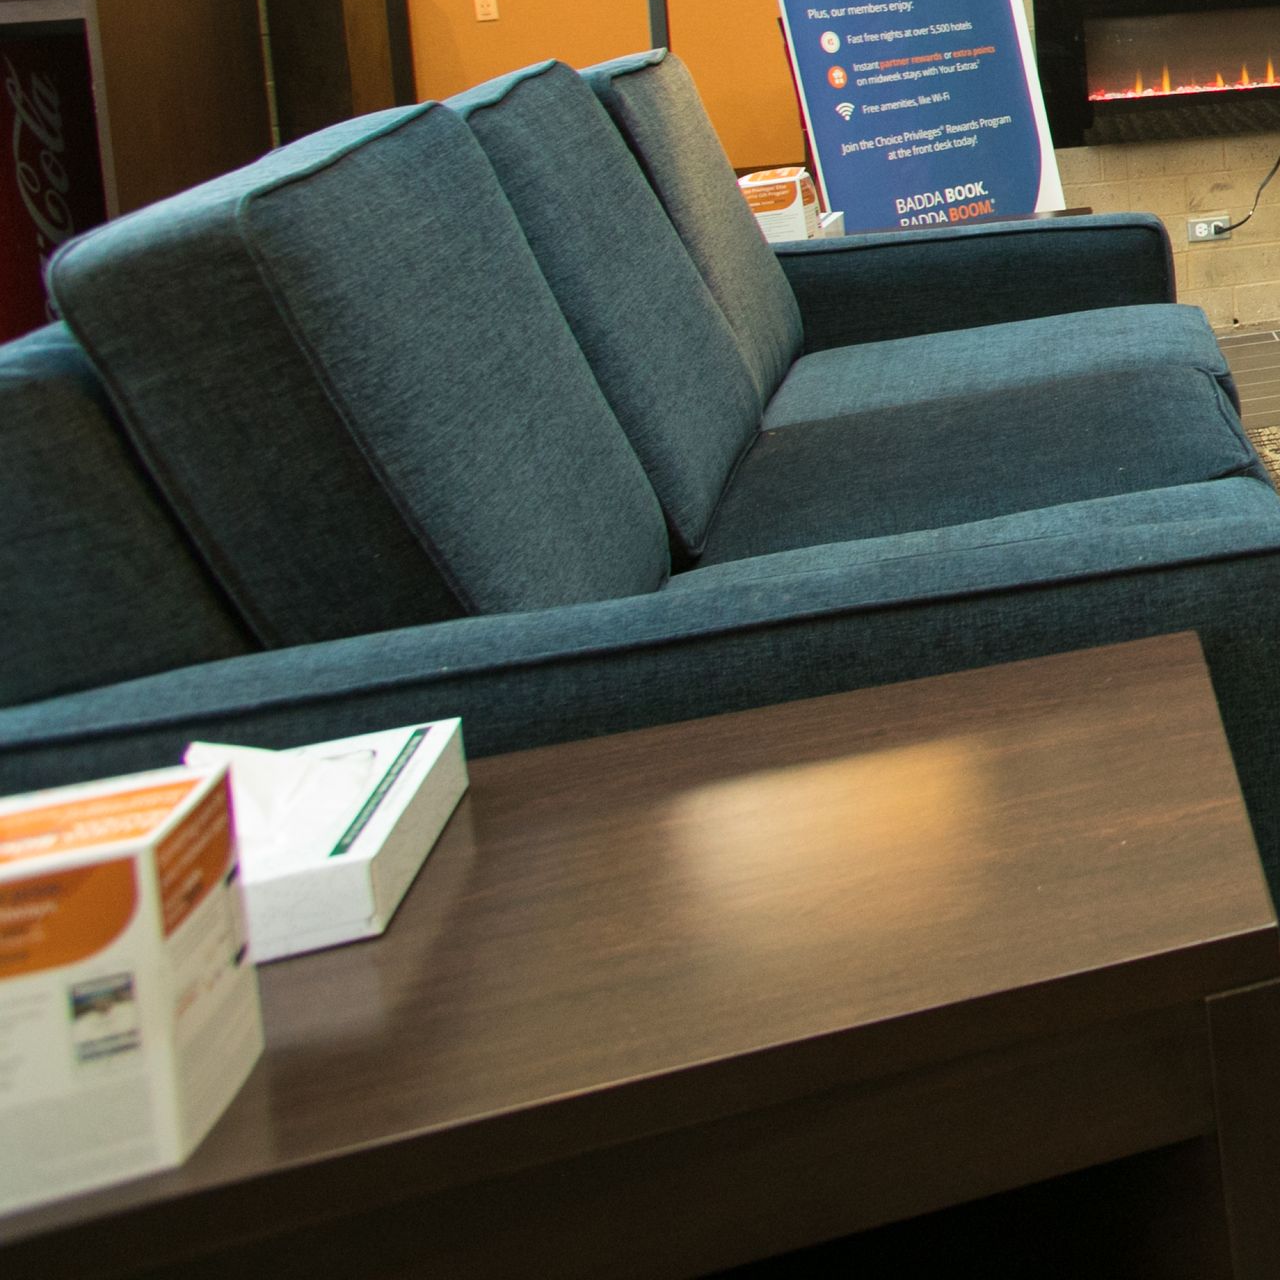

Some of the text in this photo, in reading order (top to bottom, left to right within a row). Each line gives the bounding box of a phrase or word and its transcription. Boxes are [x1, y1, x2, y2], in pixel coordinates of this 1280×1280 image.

[807, 0, 914, 20] Plus, our members enjoy:
[847, 21, 973, 44] Fast free nights at over 5,500 hotels
[853, 45, 996, 72] Instant partner rewards or extra points
[856, 77, 868, 86] on
[868, 72, 902, 85] midweek
[902, 69, 922, 81] stays
[922, 66, 938, 77] with
[938, 63, 957, 75] Your
[862, 91, 950, 115] Free amenities, like Wi-Fi
[841, 142, 859, 156] Join
[859, 140, 874, 151] the
[874, 134, 904, 148] Choice
[945, 120, 979, 134] Rewards
[980, 115, 1012, 129] Program
[888, 135, 978, 161] at the front desk today!
[896, 181, 989, 214] BADDA BOOK.
